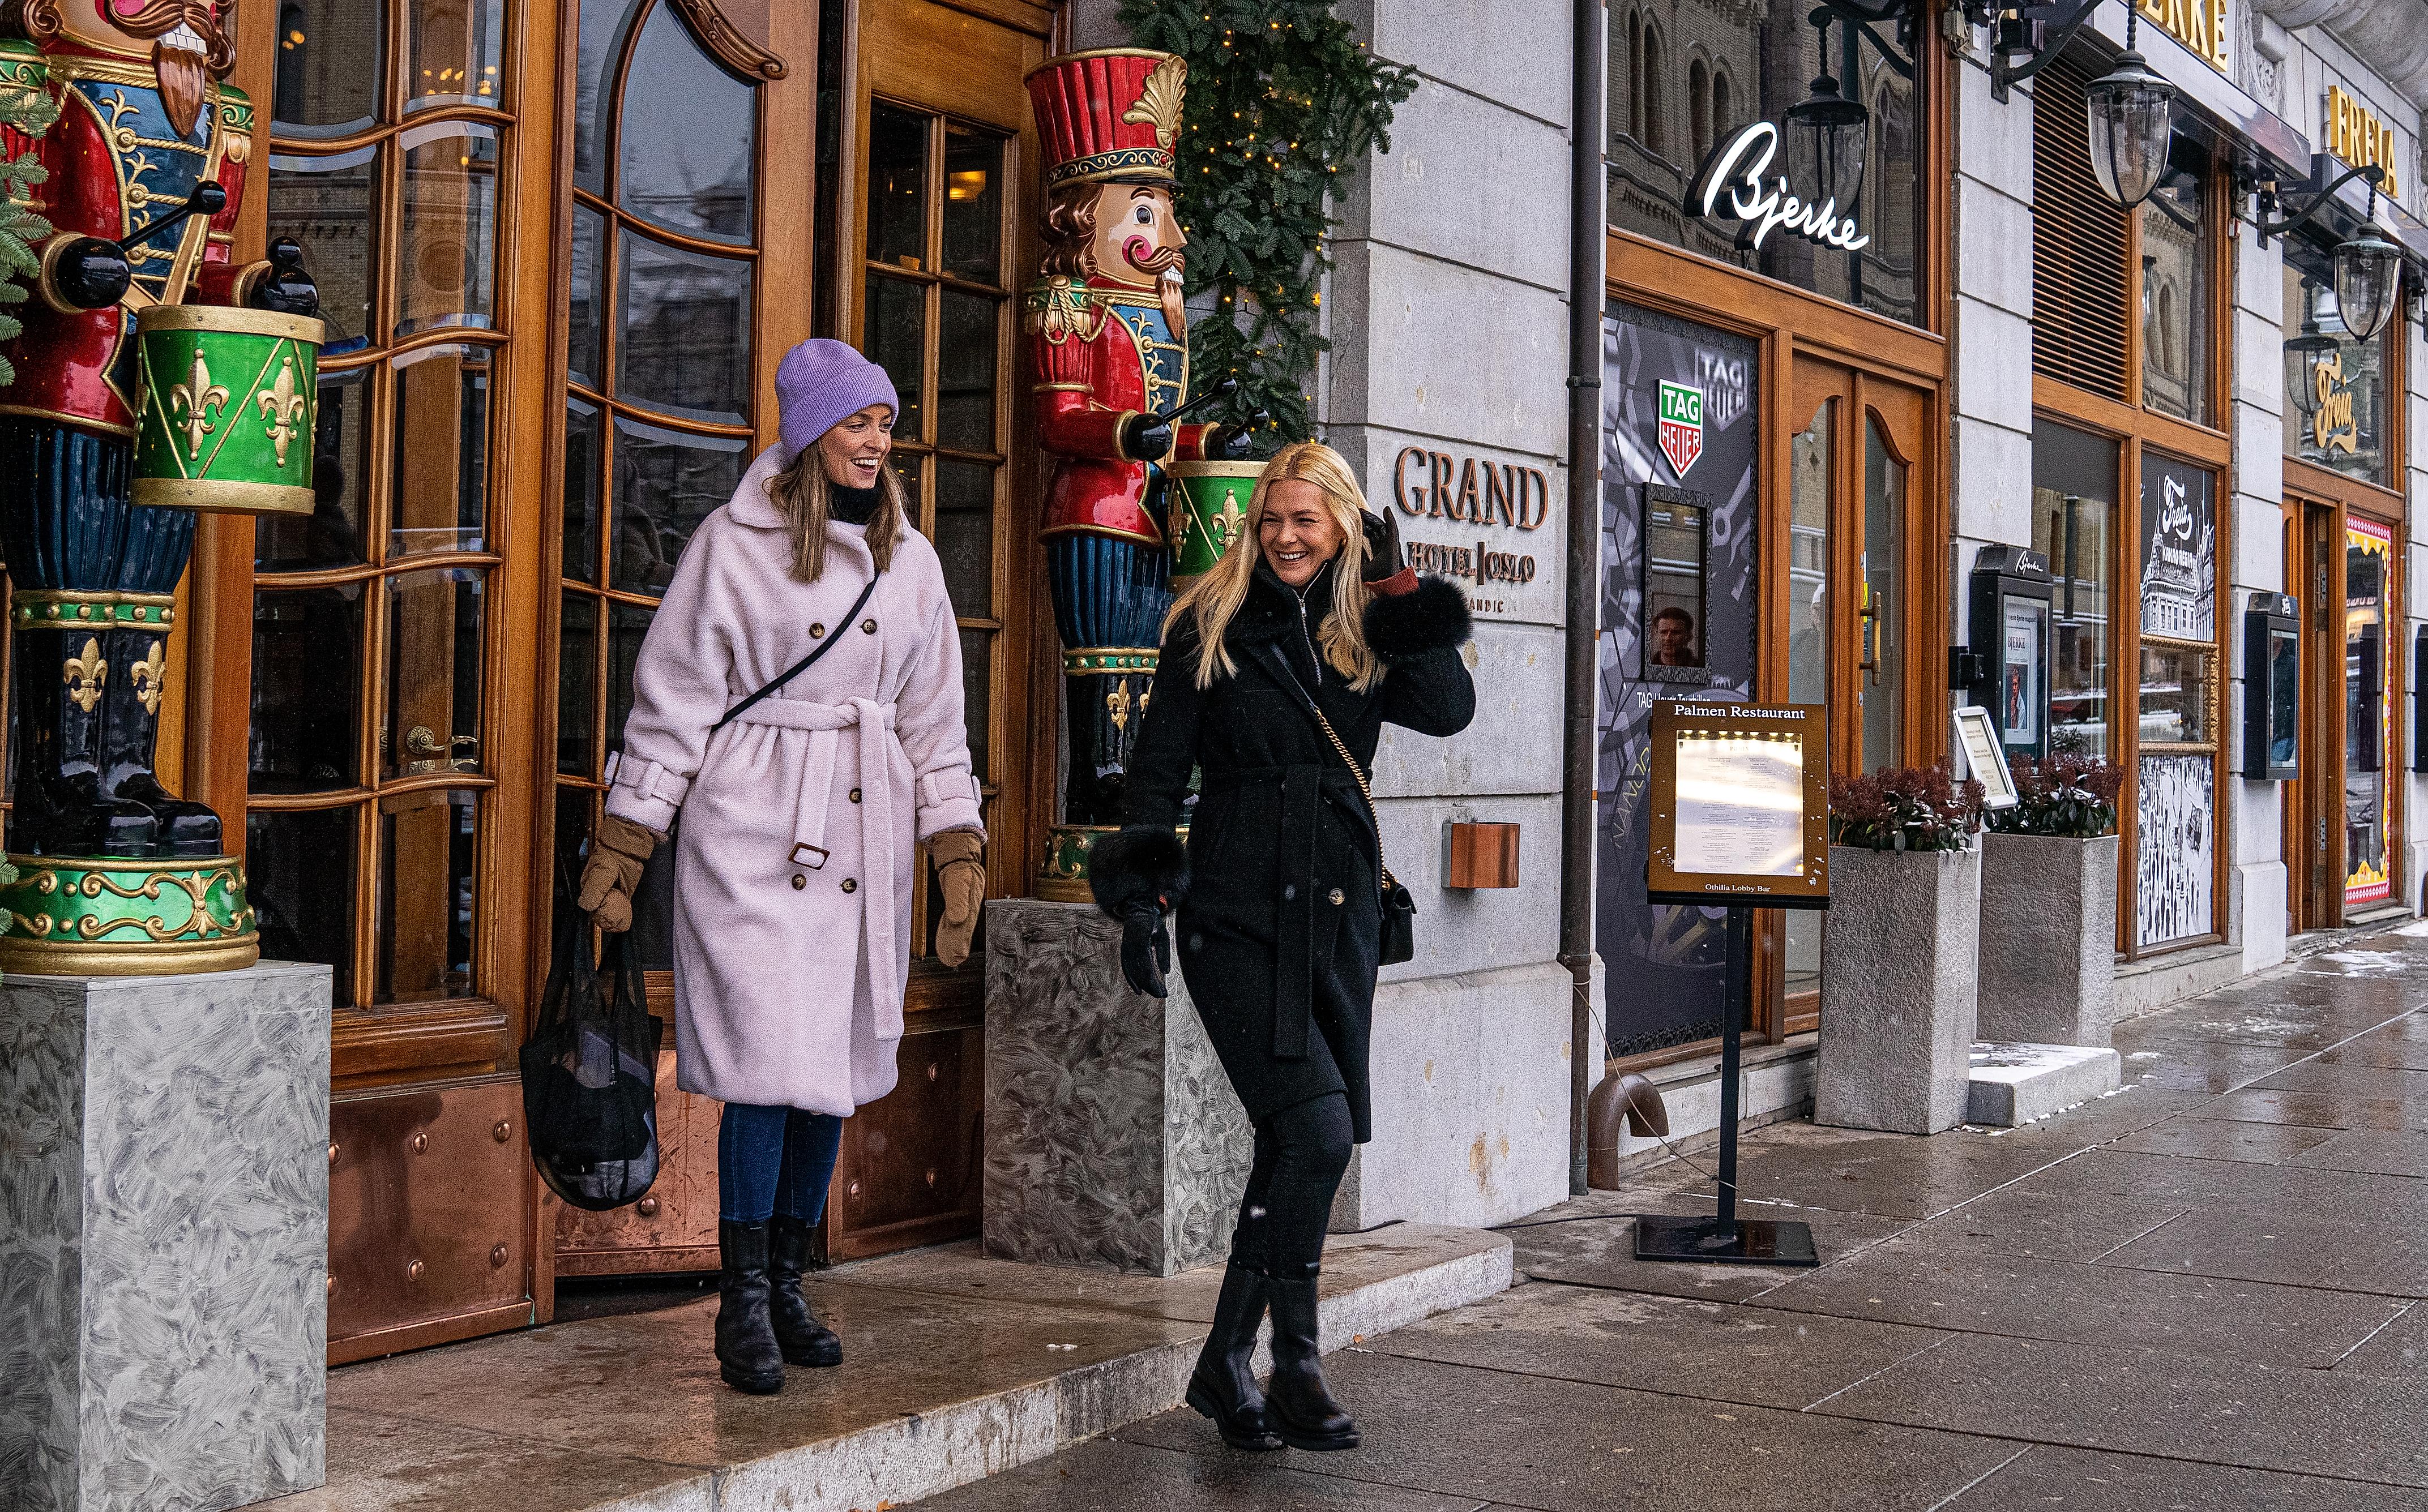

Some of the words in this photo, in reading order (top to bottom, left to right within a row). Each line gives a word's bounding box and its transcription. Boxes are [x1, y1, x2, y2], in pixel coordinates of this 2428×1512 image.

[2329, 85, 2399, 199] FREIA
[1703, 121, 1869, 251] Bjerke
[1700, 350, 1743, 388] TAG
[1663, 388, 1699, 421] TAG
[2314, 353, 2357, 453] Freia
[1661, 423, 1700, 466] HEUER
[1394, 446, 1549, 530] GRAND
[2162, 474, 2193, 541] Freia
[1407, 541, 1477, 576] HOTEL
[1485, 551, 1536, 582] OSLO
[2015, 550, 2044, 576] Bjerke
[2162, 545, 2179, 566] KAKAO
[2179, 550, 2193, 569] REGIA
[1469, 597, 1504, 613] ANDIC
[2007, 636, 2026, 651] BJERKE
[1637, 692, 1653, 708] TAG
[1674, 704, 1726, 717] Palmen
[1730, 706, 1806, 719] Restaurant
